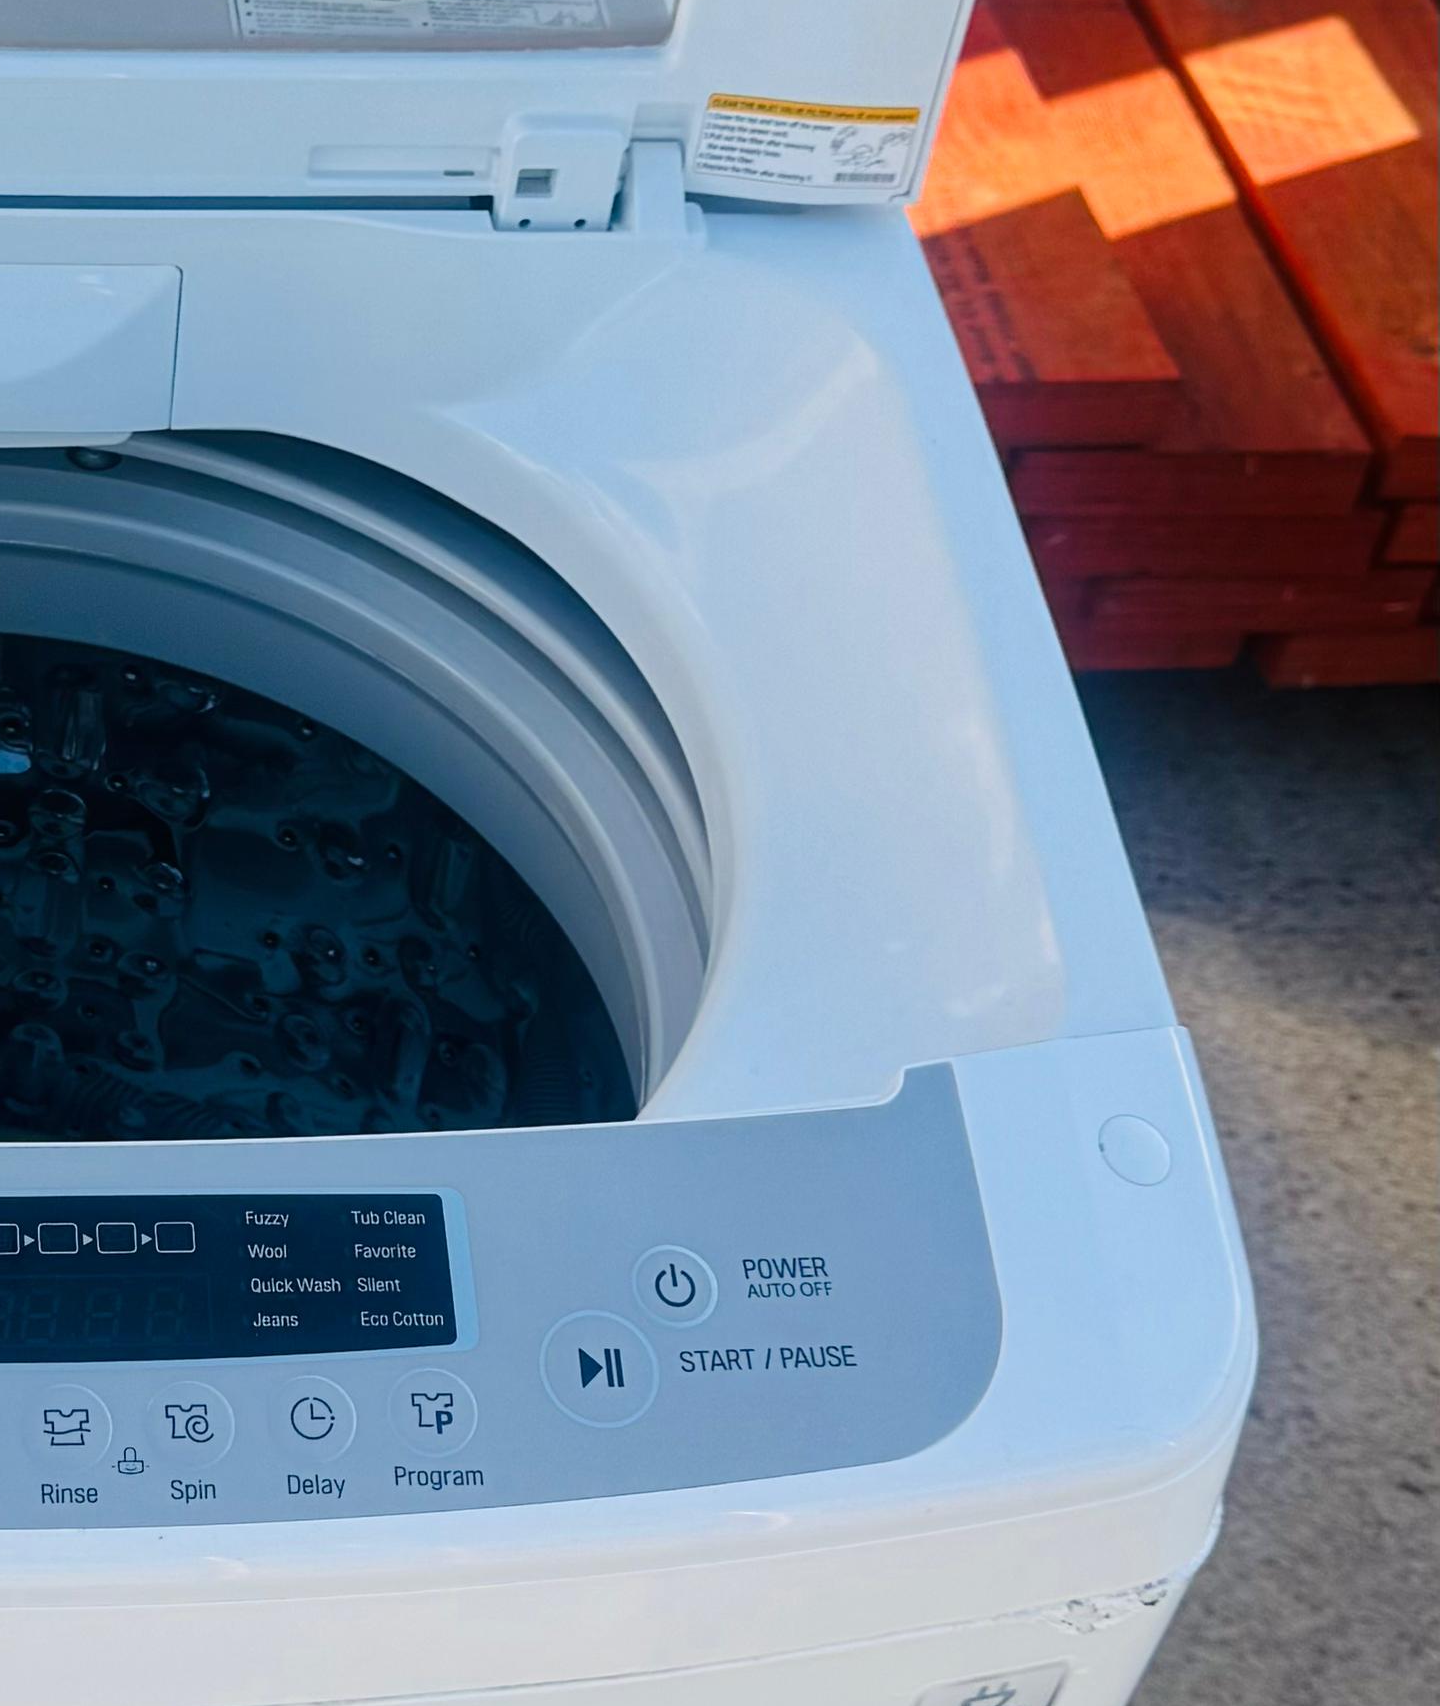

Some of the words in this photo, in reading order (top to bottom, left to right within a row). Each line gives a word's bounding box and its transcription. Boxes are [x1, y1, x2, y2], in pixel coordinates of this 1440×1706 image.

[245, 1211, 289, 1228] Fuzzy
[351, 1211, 380, 1226] Tub
[383, 1211, 426, 1226] Clean
[248, 1245, 287, 1259] Wool
[354, 1244, 417, 1259] Favorite
[742, 1257, 828, 1280] POWER
[250, 1278, 294, 1294] Quick
[297, 1278, 341, 1293] Wash
[357, 1278, 401, 1293] Silent
[747, 1282, 796, 1299] AUTO
[799, 1281, 833, 1298] OFF
[253, 1312, 299, 1329] Jeans
[360, 1312, 389, 1327] Eco
[392, 1311, 444, 1327] Cotton
[680, 1348, 755, 1373] START
[780, 1345, 857, 1369] PAUSE
[287, 1475, 346, 1499] Delay
[394, 1466, 484, 1491] Program
[40, 1483, 99, 1505] Rinse
[171, 1480, 217, 1504] Spin
